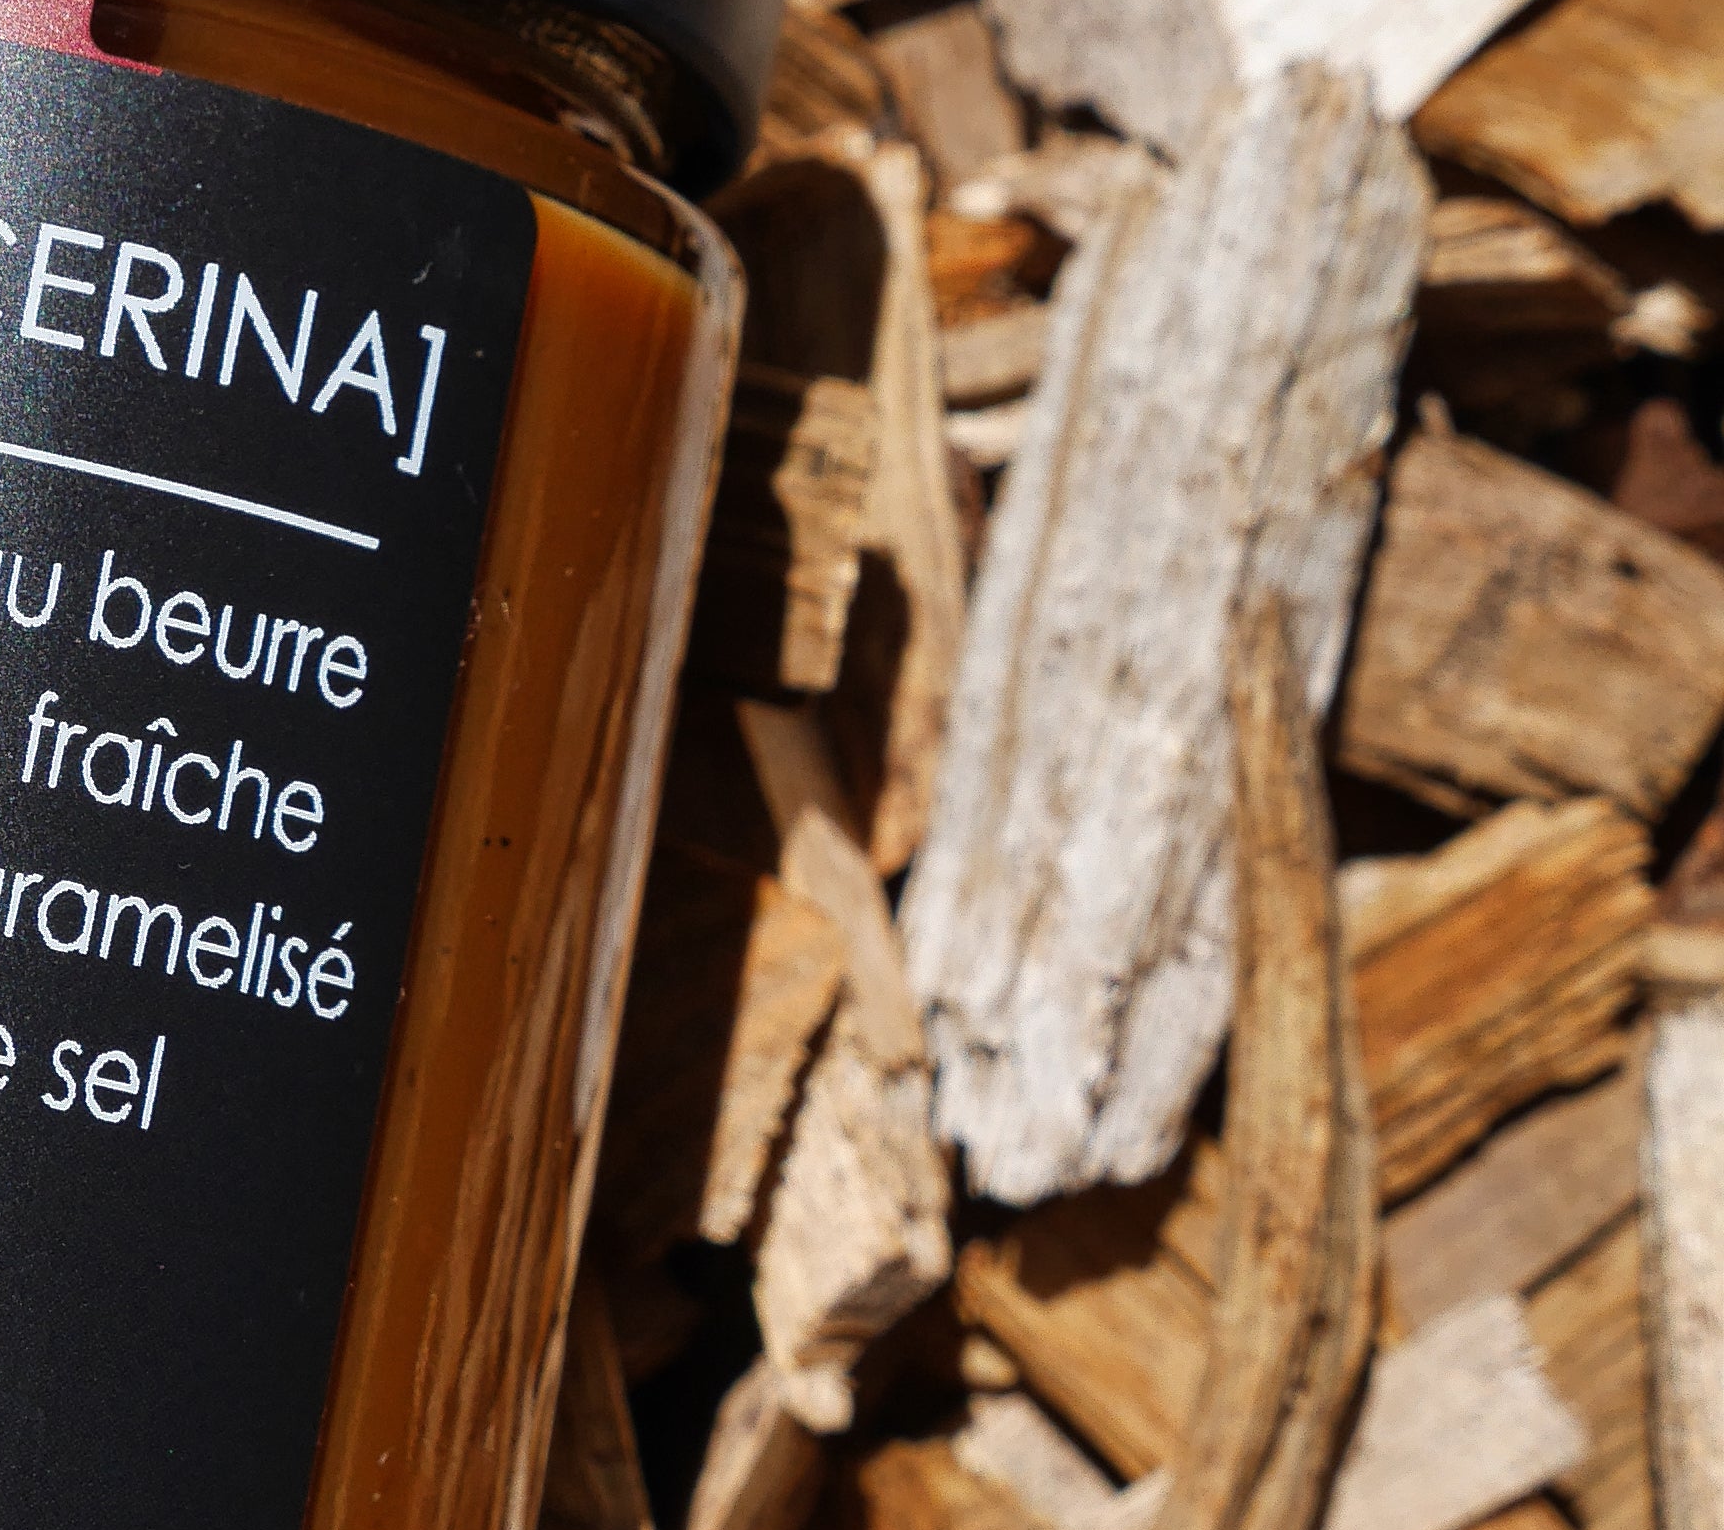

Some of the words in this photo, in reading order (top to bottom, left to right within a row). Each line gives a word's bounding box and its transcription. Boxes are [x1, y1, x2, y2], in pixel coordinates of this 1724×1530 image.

[87, 549, 370, 709] beurre
[18, 691, 325, 853] fraîche
[42, 1034, 162, 1130] sel
